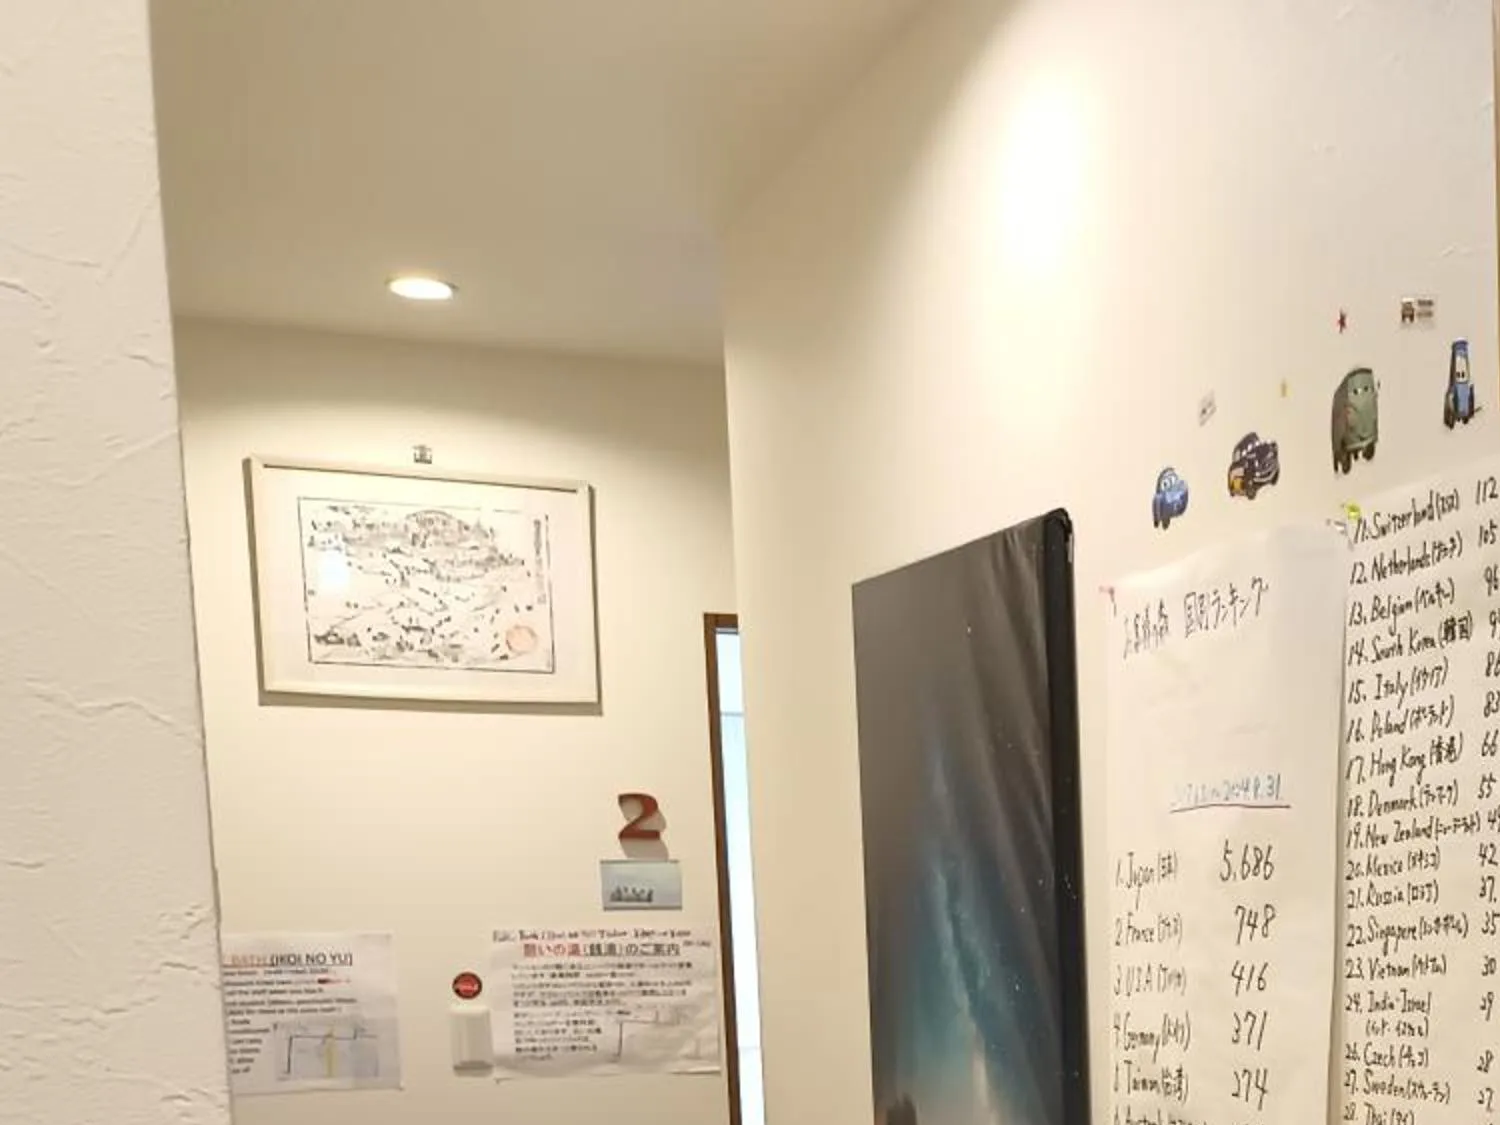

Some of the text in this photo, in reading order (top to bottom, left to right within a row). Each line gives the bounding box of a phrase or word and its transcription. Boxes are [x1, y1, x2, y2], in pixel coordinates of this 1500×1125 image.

[1475, 475, 1500, 506] 112
[1477, 517, 1499, 548] 105
[1481, 728, 1500, 758] 66
[1477, 771, 1499, 801] 55
[617, 792, 662, 840] 2
[1219, 839, 1275, 881] 5,686
[1478, 842, 1500, 868] 42
[1233, 902, 1277, 944] 748
[1231, 959, 1269, 997] 416
[1481, 955, 1498, 977] 30
[1479, 990, 1496, 1023] 29
[1231, 1011, 1267, 1052] 371
[1476, 1048, 1495, 1074] 28
[1231, 1068, 1269, 1111] 274
[1477, 1086, 1496, 1114] 27
